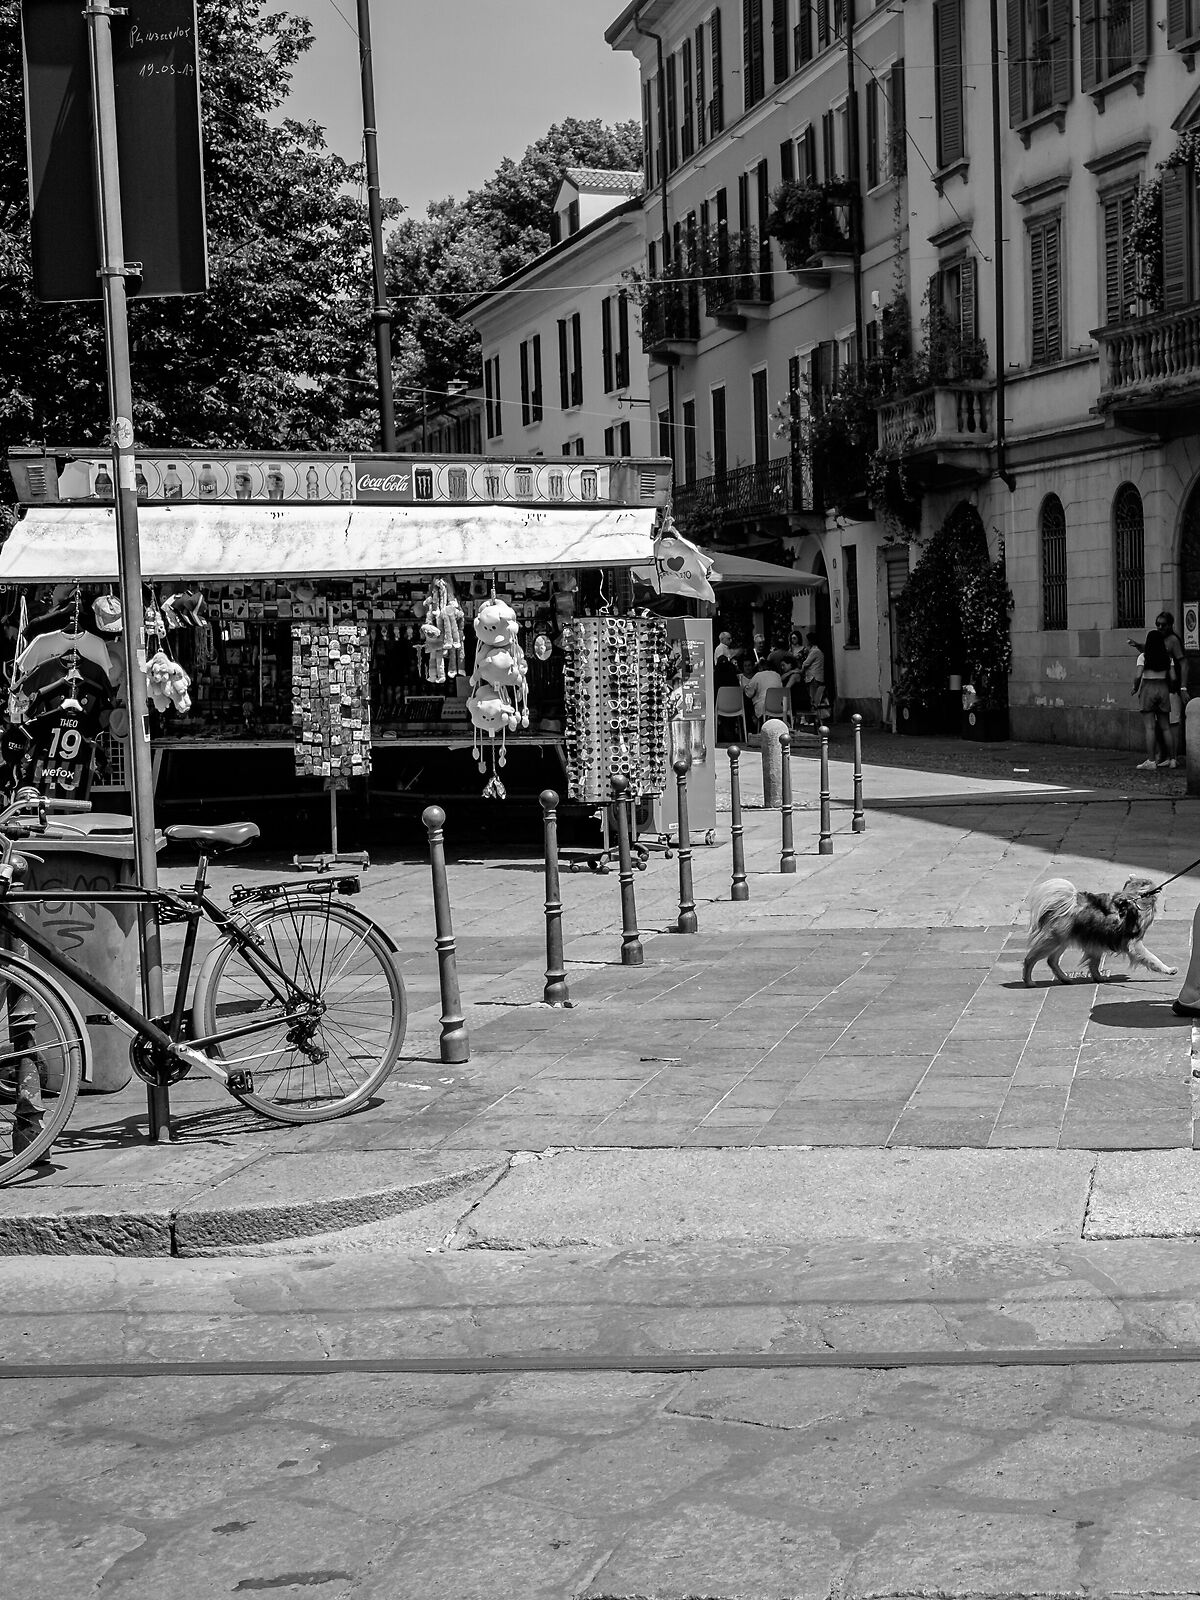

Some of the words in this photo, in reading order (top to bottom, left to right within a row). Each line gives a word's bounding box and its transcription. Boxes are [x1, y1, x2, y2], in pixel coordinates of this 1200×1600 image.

[356, 473, 412, 492] Coca-Cola
[60, 718, 79, 728] THEO
[48, 727, 82, 760] 19
[41, 766, 76, 781] wefox
